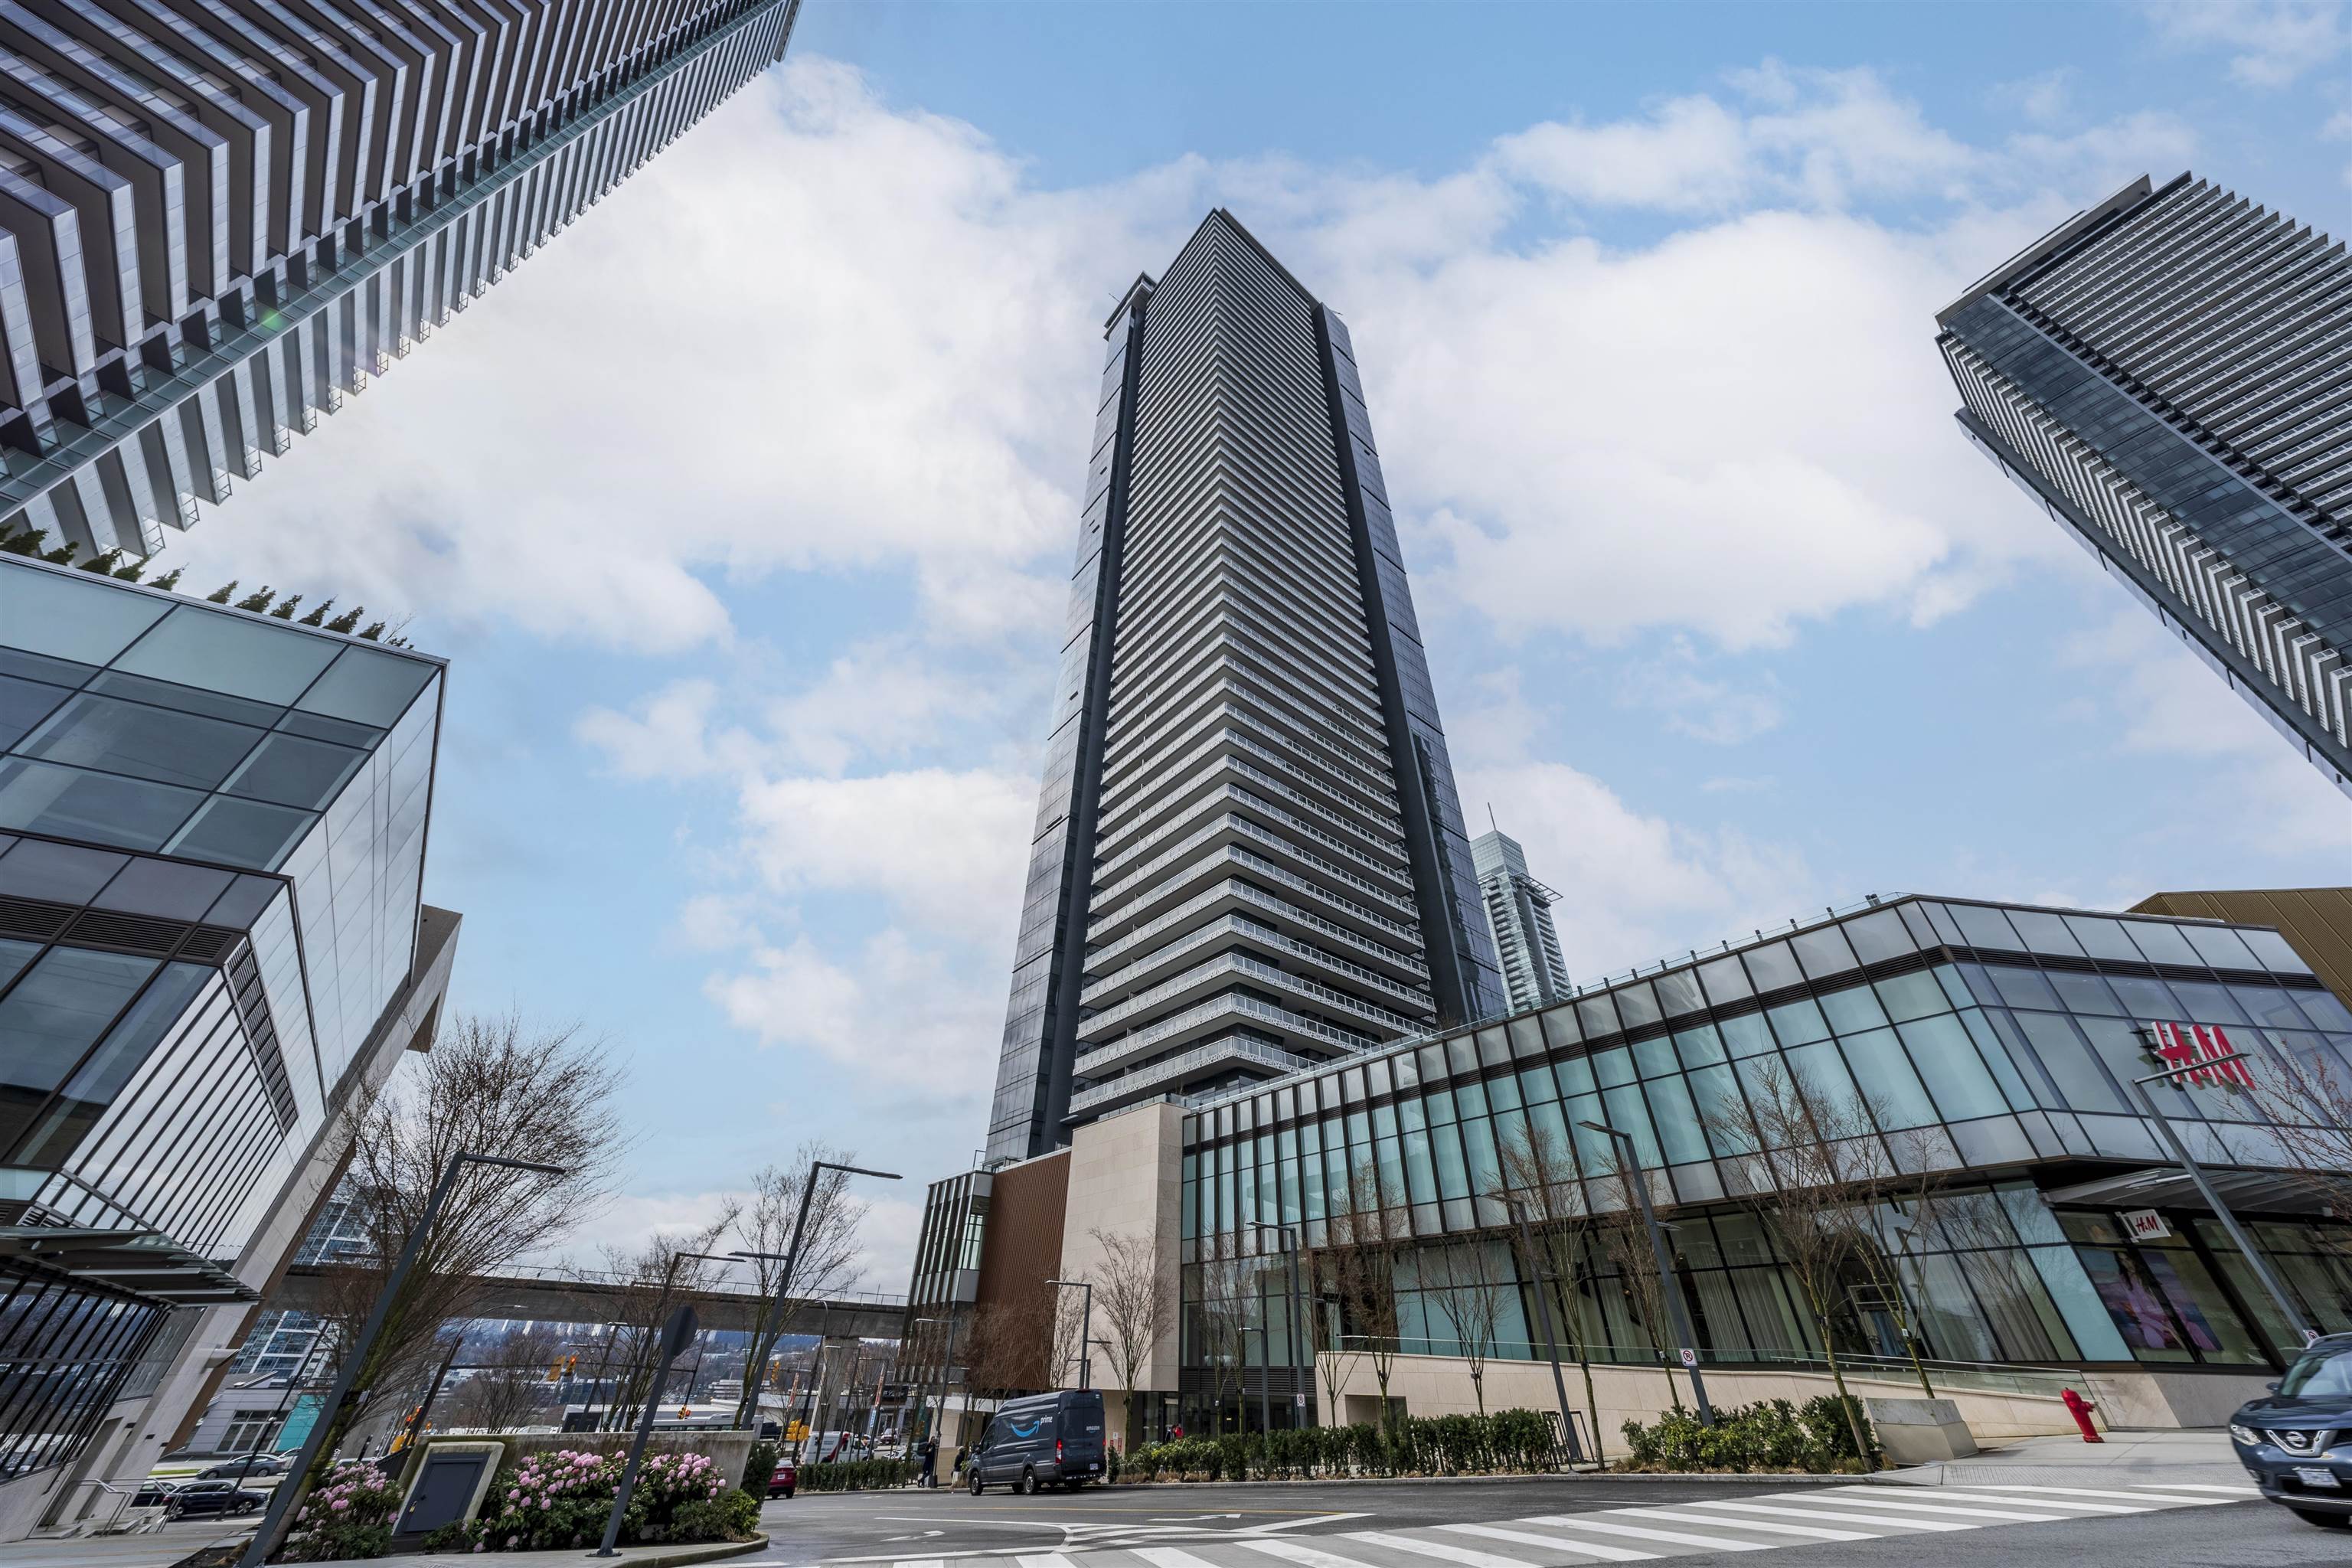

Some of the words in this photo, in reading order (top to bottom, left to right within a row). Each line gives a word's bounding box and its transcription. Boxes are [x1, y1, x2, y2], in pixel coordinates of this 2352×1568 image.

[2151, 1021, 2257, 1091] H&M
[2135, 1215, 2160, 1233] H&M
[1040, 1415, 1053, 1426] prime
